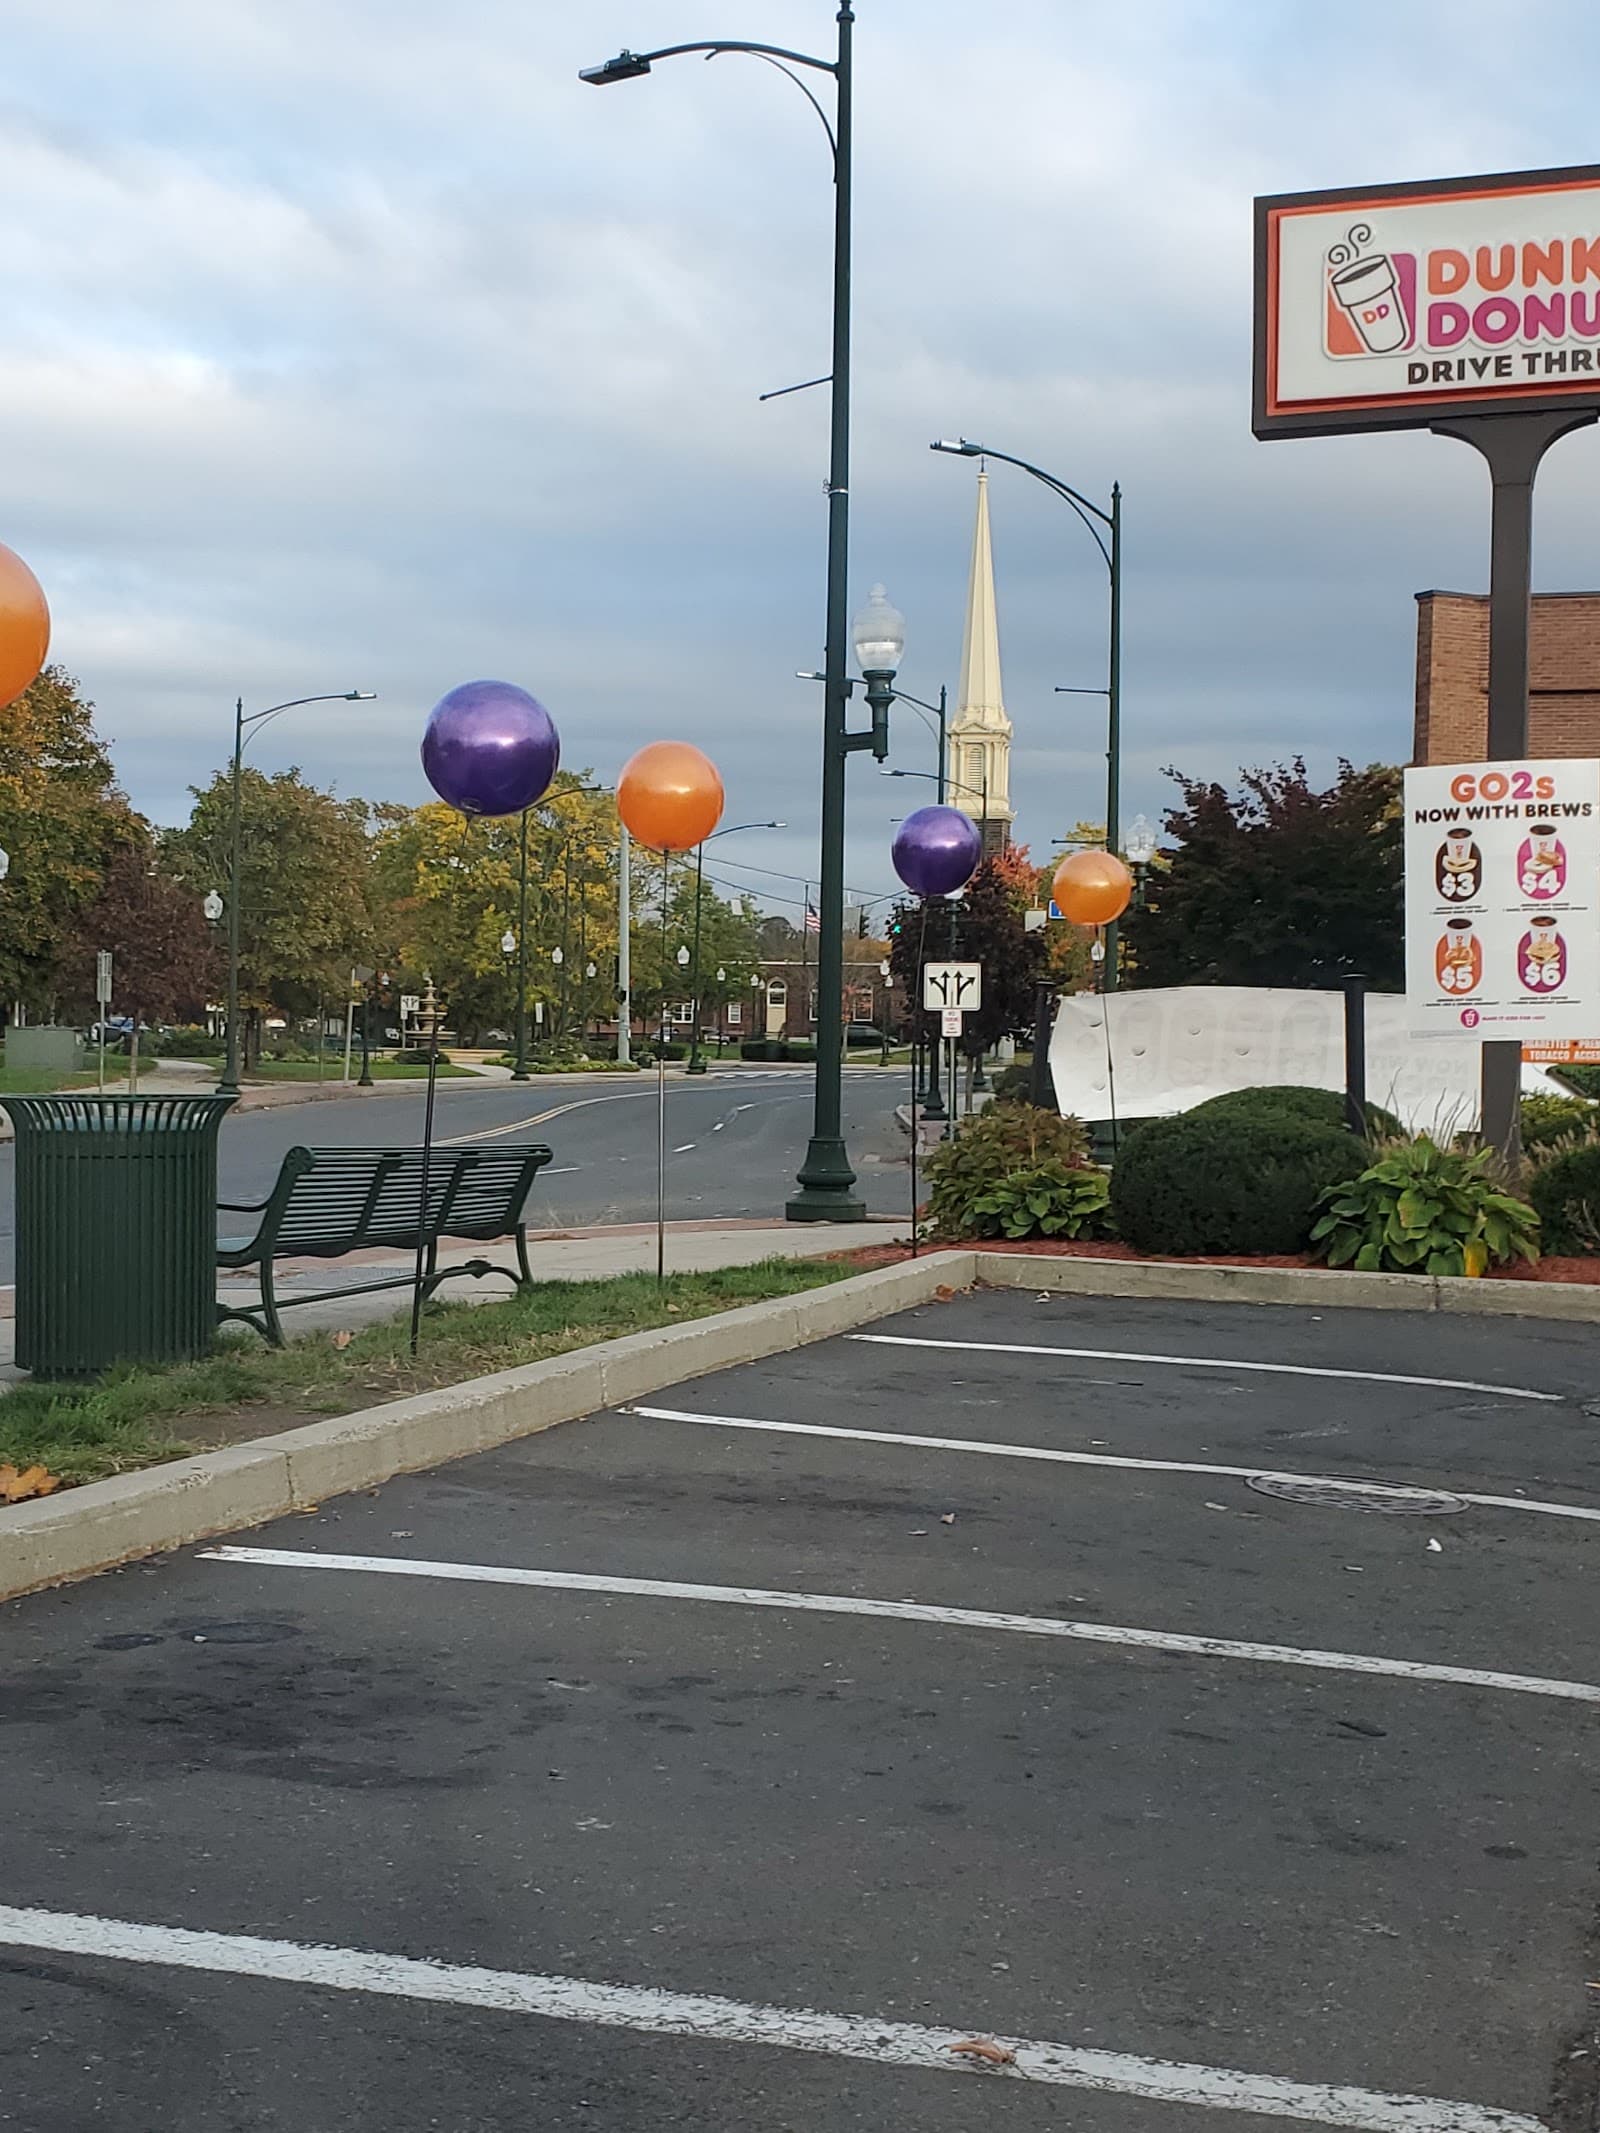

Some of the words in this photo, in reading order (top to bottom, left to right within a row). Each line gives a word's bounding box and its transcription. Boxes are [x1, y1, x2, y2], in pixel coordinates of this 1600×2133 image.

[1362, 303, 1390, 325] DD
[1407, 355, 1513, 385] DRIVE
[1522, 348, 1600, 375] THR
[1415, 807, 1461, 824] NOW
[1465, 803, 1519, 821] WITH
[1525, 802, 1593, 818] BREWS
[1441, 872, 1475, 898] $3
[1521, 869, 1561, 895] $4
[1441, 965, 1474, 990] $5
[1524, 961, 1561, 987] $6
